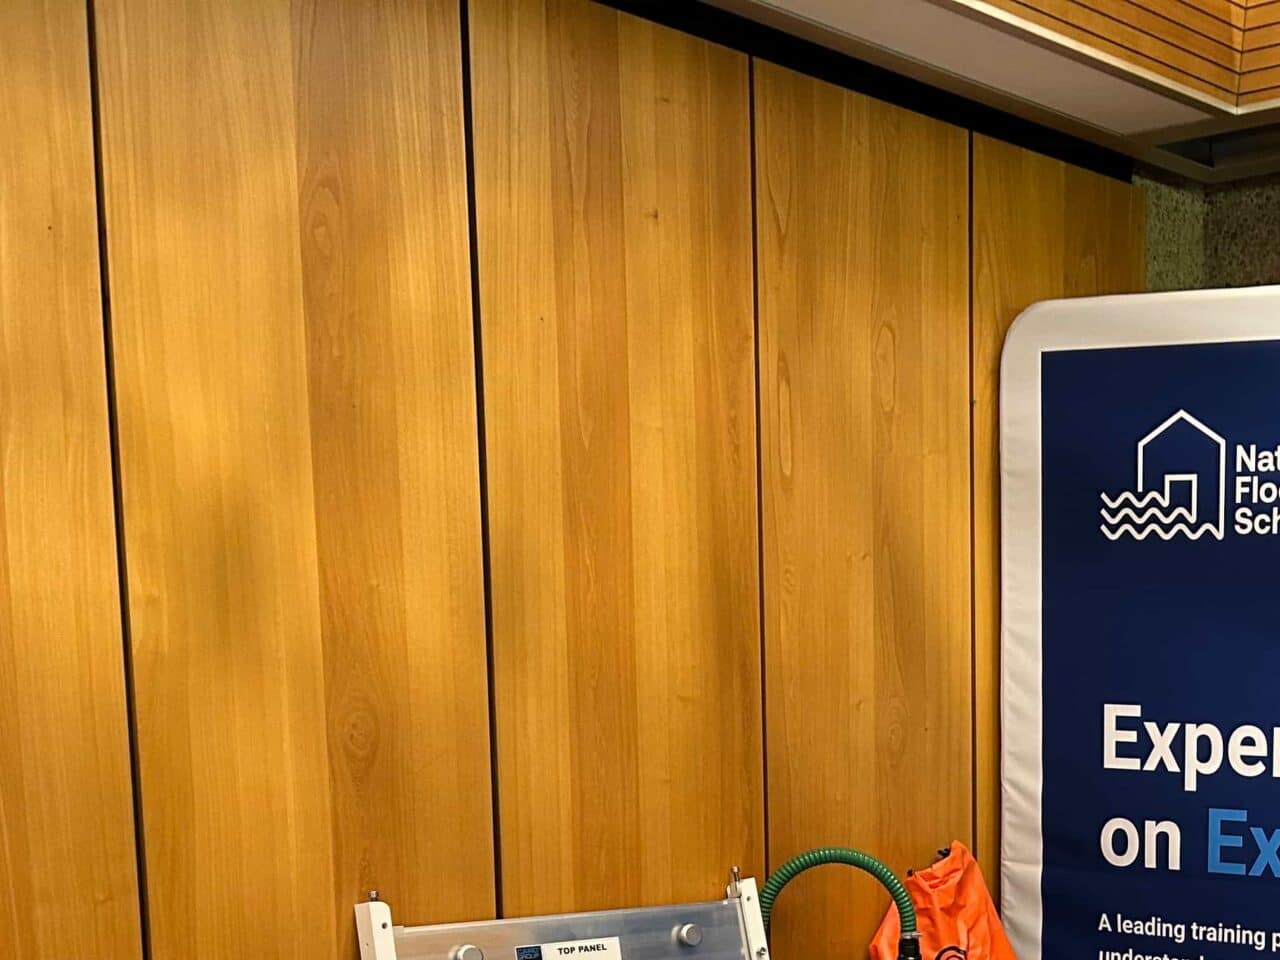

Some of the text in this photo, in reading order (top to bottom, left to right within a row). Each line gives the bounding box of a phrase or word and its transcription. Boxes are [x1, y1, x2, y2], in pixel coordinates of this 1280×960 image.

[1101, 818, 1180, 870] on
[558, 943, 607, 955] TOP PANEL
[1099, 914, 1112, 931] A
[1117, 914, 1185, 943] leading
[1191, 923, 1265, 950] training
